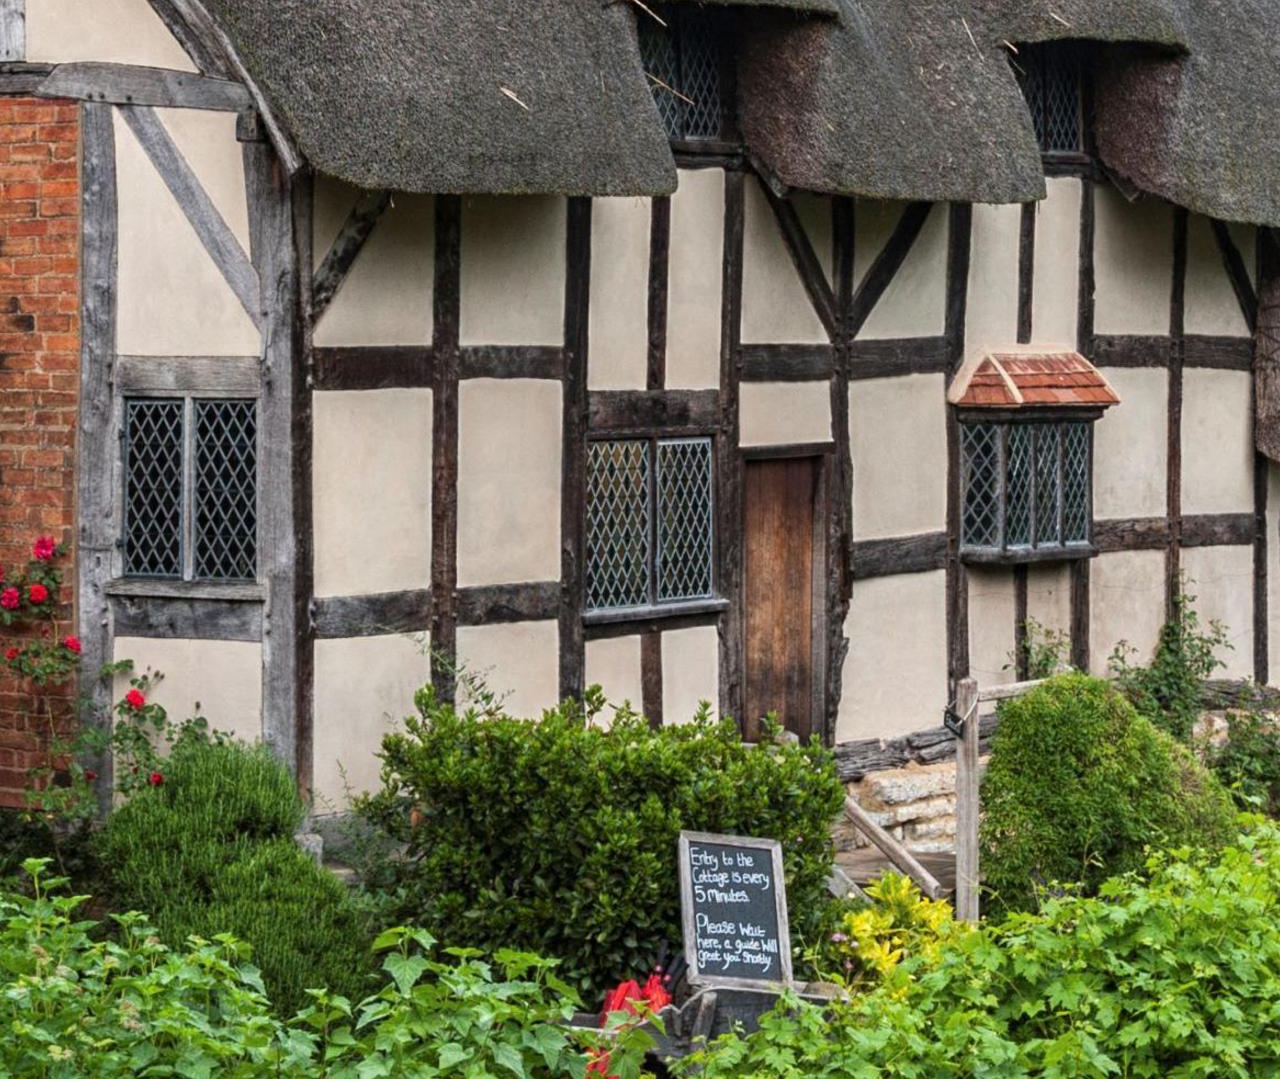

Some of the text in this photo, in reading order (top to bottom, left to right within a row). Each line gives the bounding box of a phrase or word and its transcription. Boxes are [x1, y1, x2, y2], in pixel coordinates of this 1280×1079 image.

[690, 847, 755, 871] Entry to the
[692, 866, 769, 890] Cottage is every
[694, 885, 706, 903] 5
[696, 913, 736, 934] Please
[724, 939, 733, 949] a
[734, 938, 761, 954] guide
[698, 949, 722, 968] greet
[721, 952, 741, 970] you
